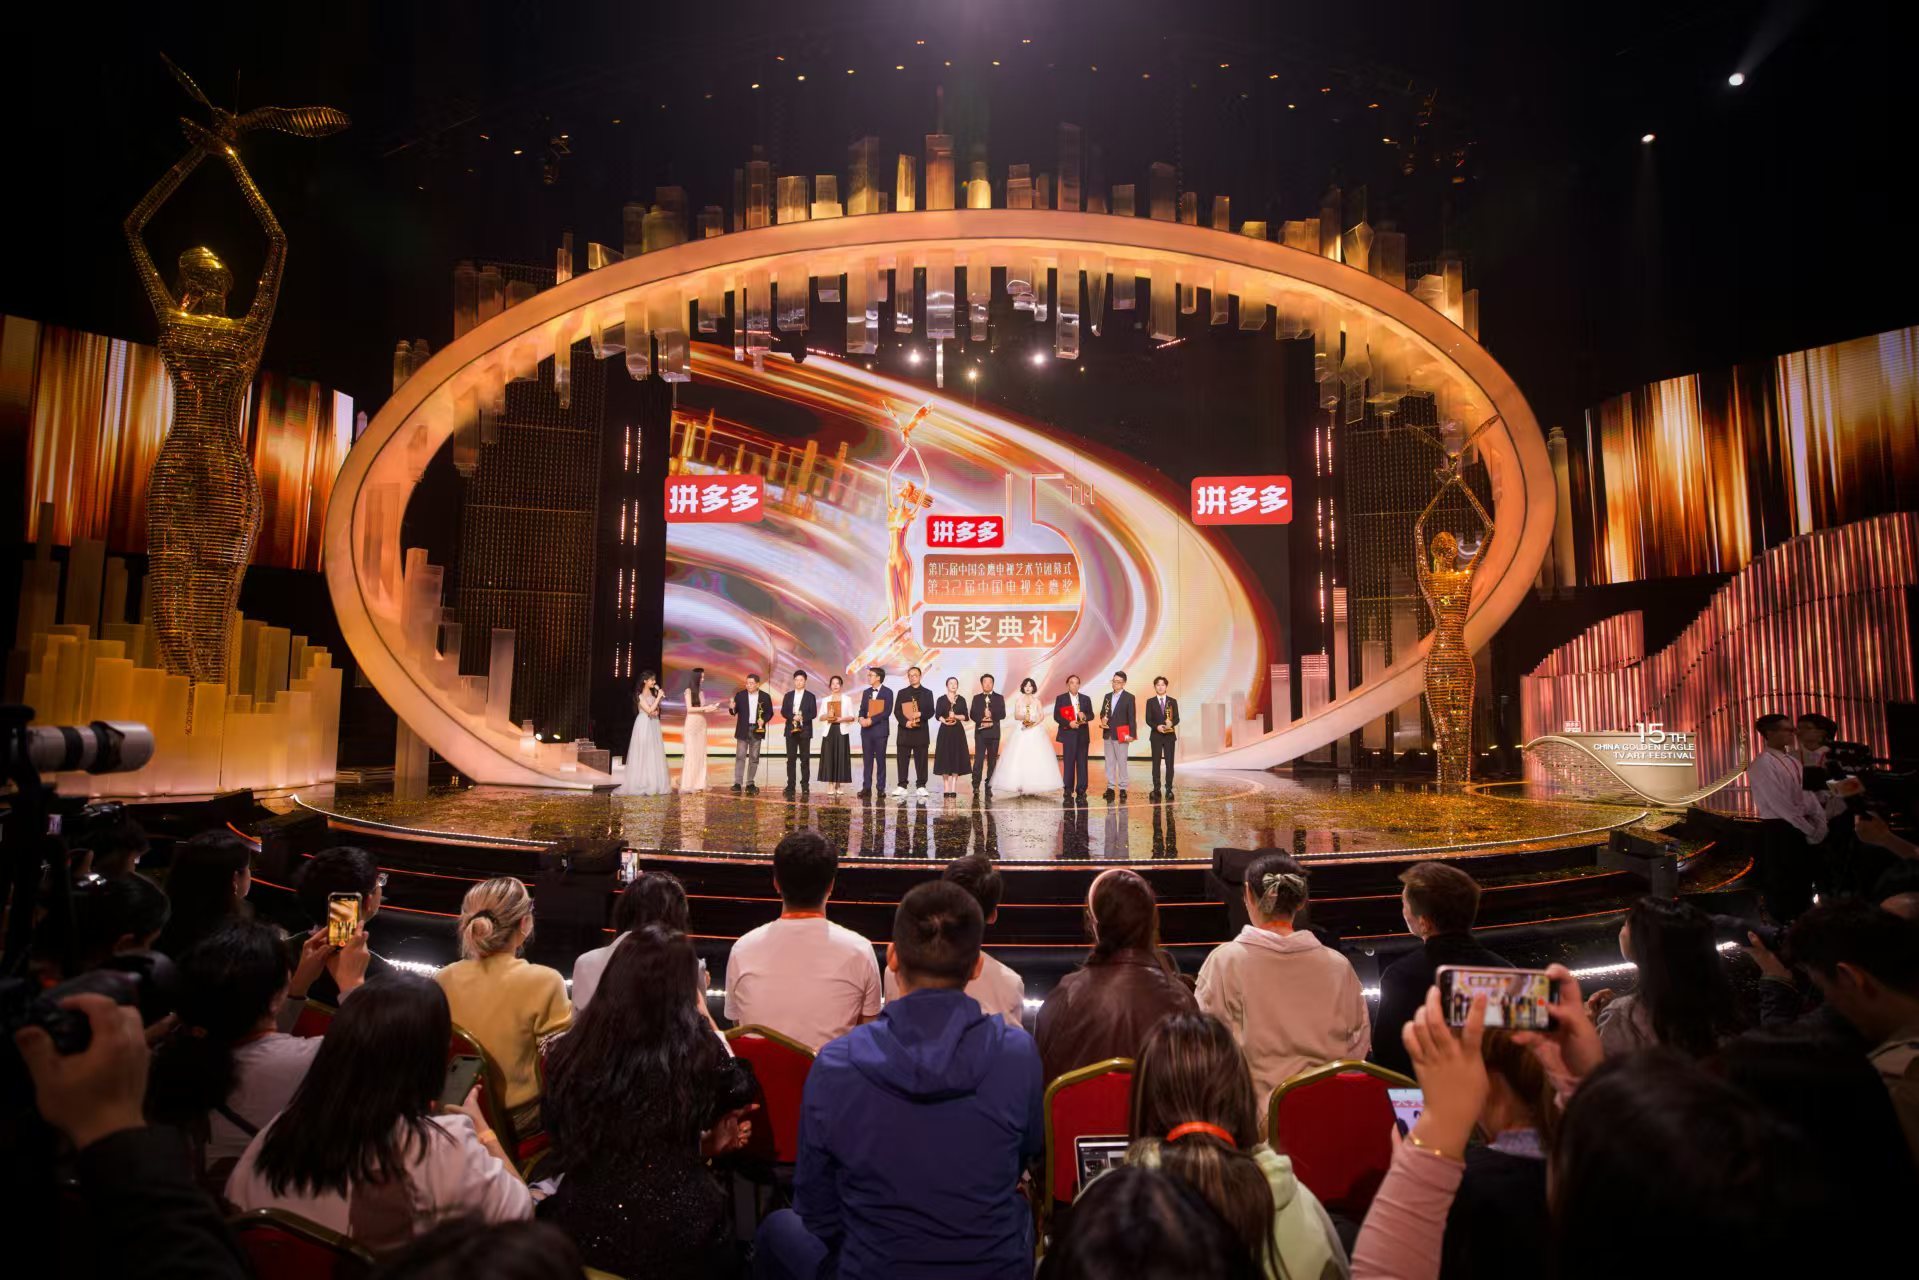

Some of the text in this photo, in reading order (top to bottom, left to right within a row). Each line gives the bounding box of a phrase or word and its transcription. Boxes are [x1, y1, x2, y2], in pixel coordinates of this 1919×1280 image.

[669, 484, 759, 513] 拼多多
[1197, 485, 1288, 515] 拼多多
[932, 521, 999, 543] 拼多多
[932, 615, 1057, 644] 颁奖典礼
[1593, 743, 1695, 751] CHINA GOLDEN EAGLE
[1613, 751, 1695, 759] TV ART FESTIVAL
